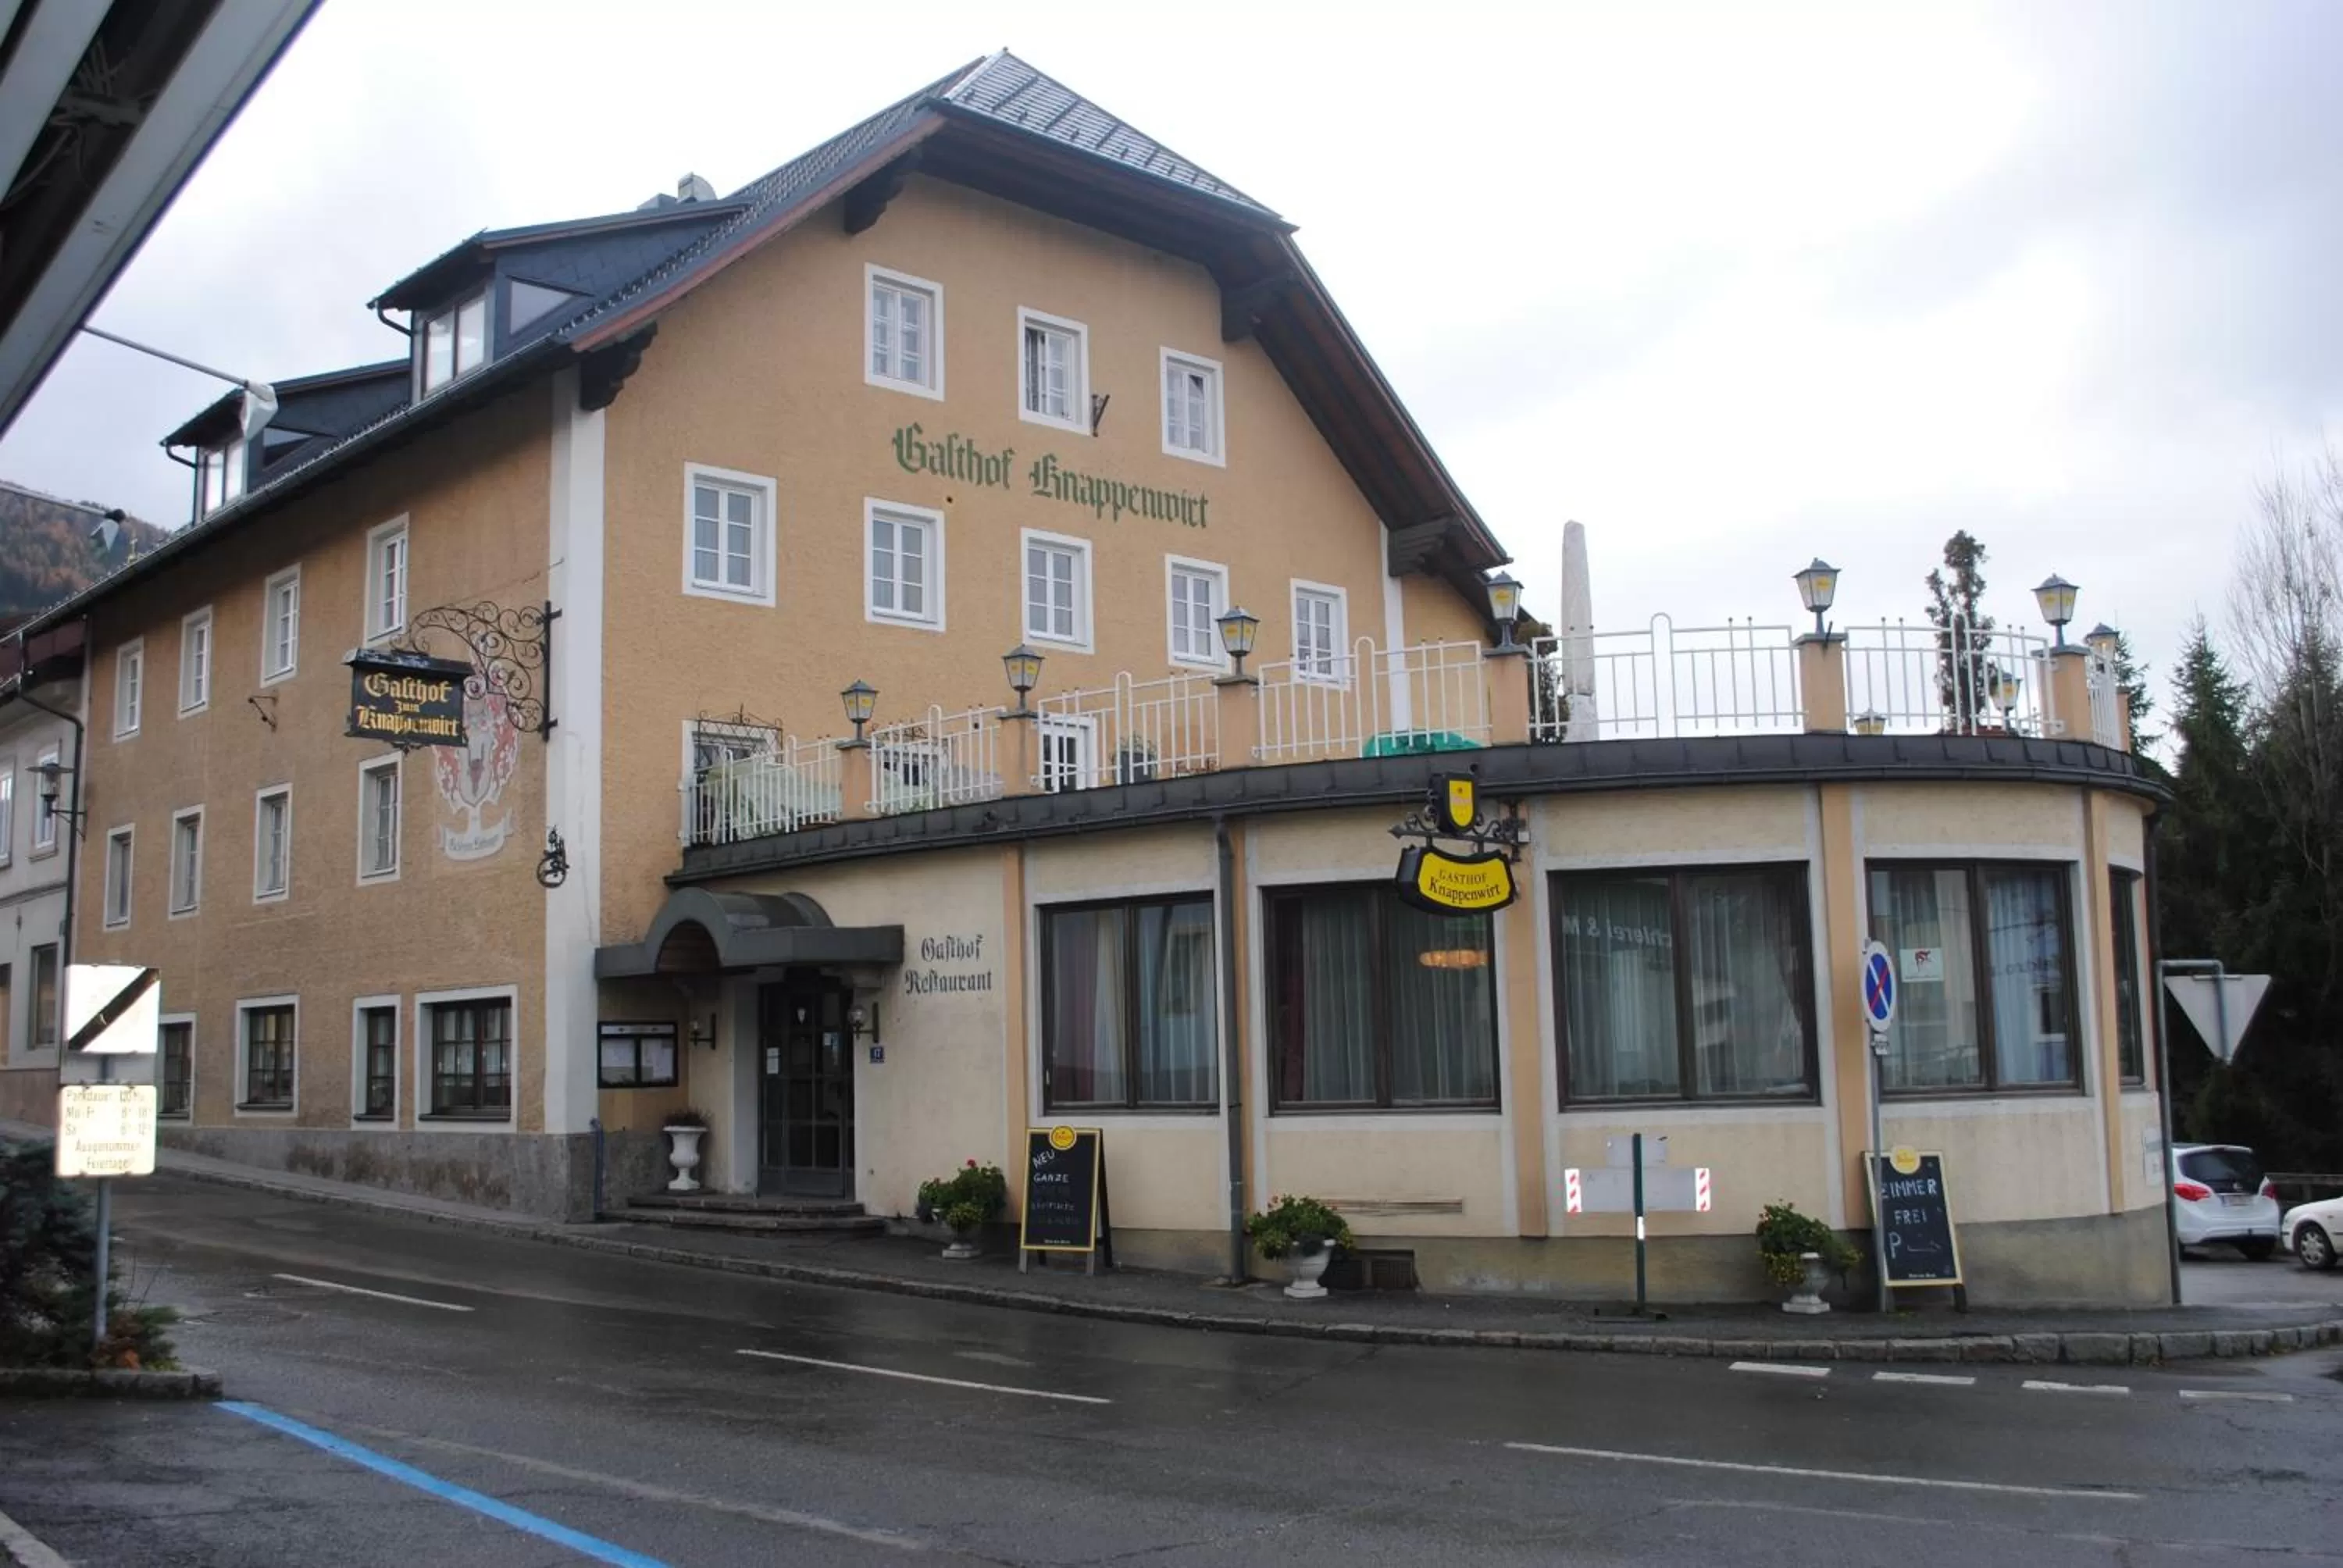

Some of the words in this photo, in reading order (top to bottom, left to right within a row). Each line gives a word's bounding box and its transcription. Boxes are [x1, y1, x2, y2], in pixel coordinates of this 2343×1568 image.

[891, 422, 1015, 490] Gasthof
[1029, 451, 1209, 529] Knappenwirt
[364, 672, 453, 703] Gasthof
[1428, 875, 1501, 905] Knappenwirt
[920, 933, 984, 963] Gasthof
[904, 968, 993, 996] Restaurant
[1893, 1208, 1928, 1225] FREI
[1888, 1231, 1902, 1260] P
